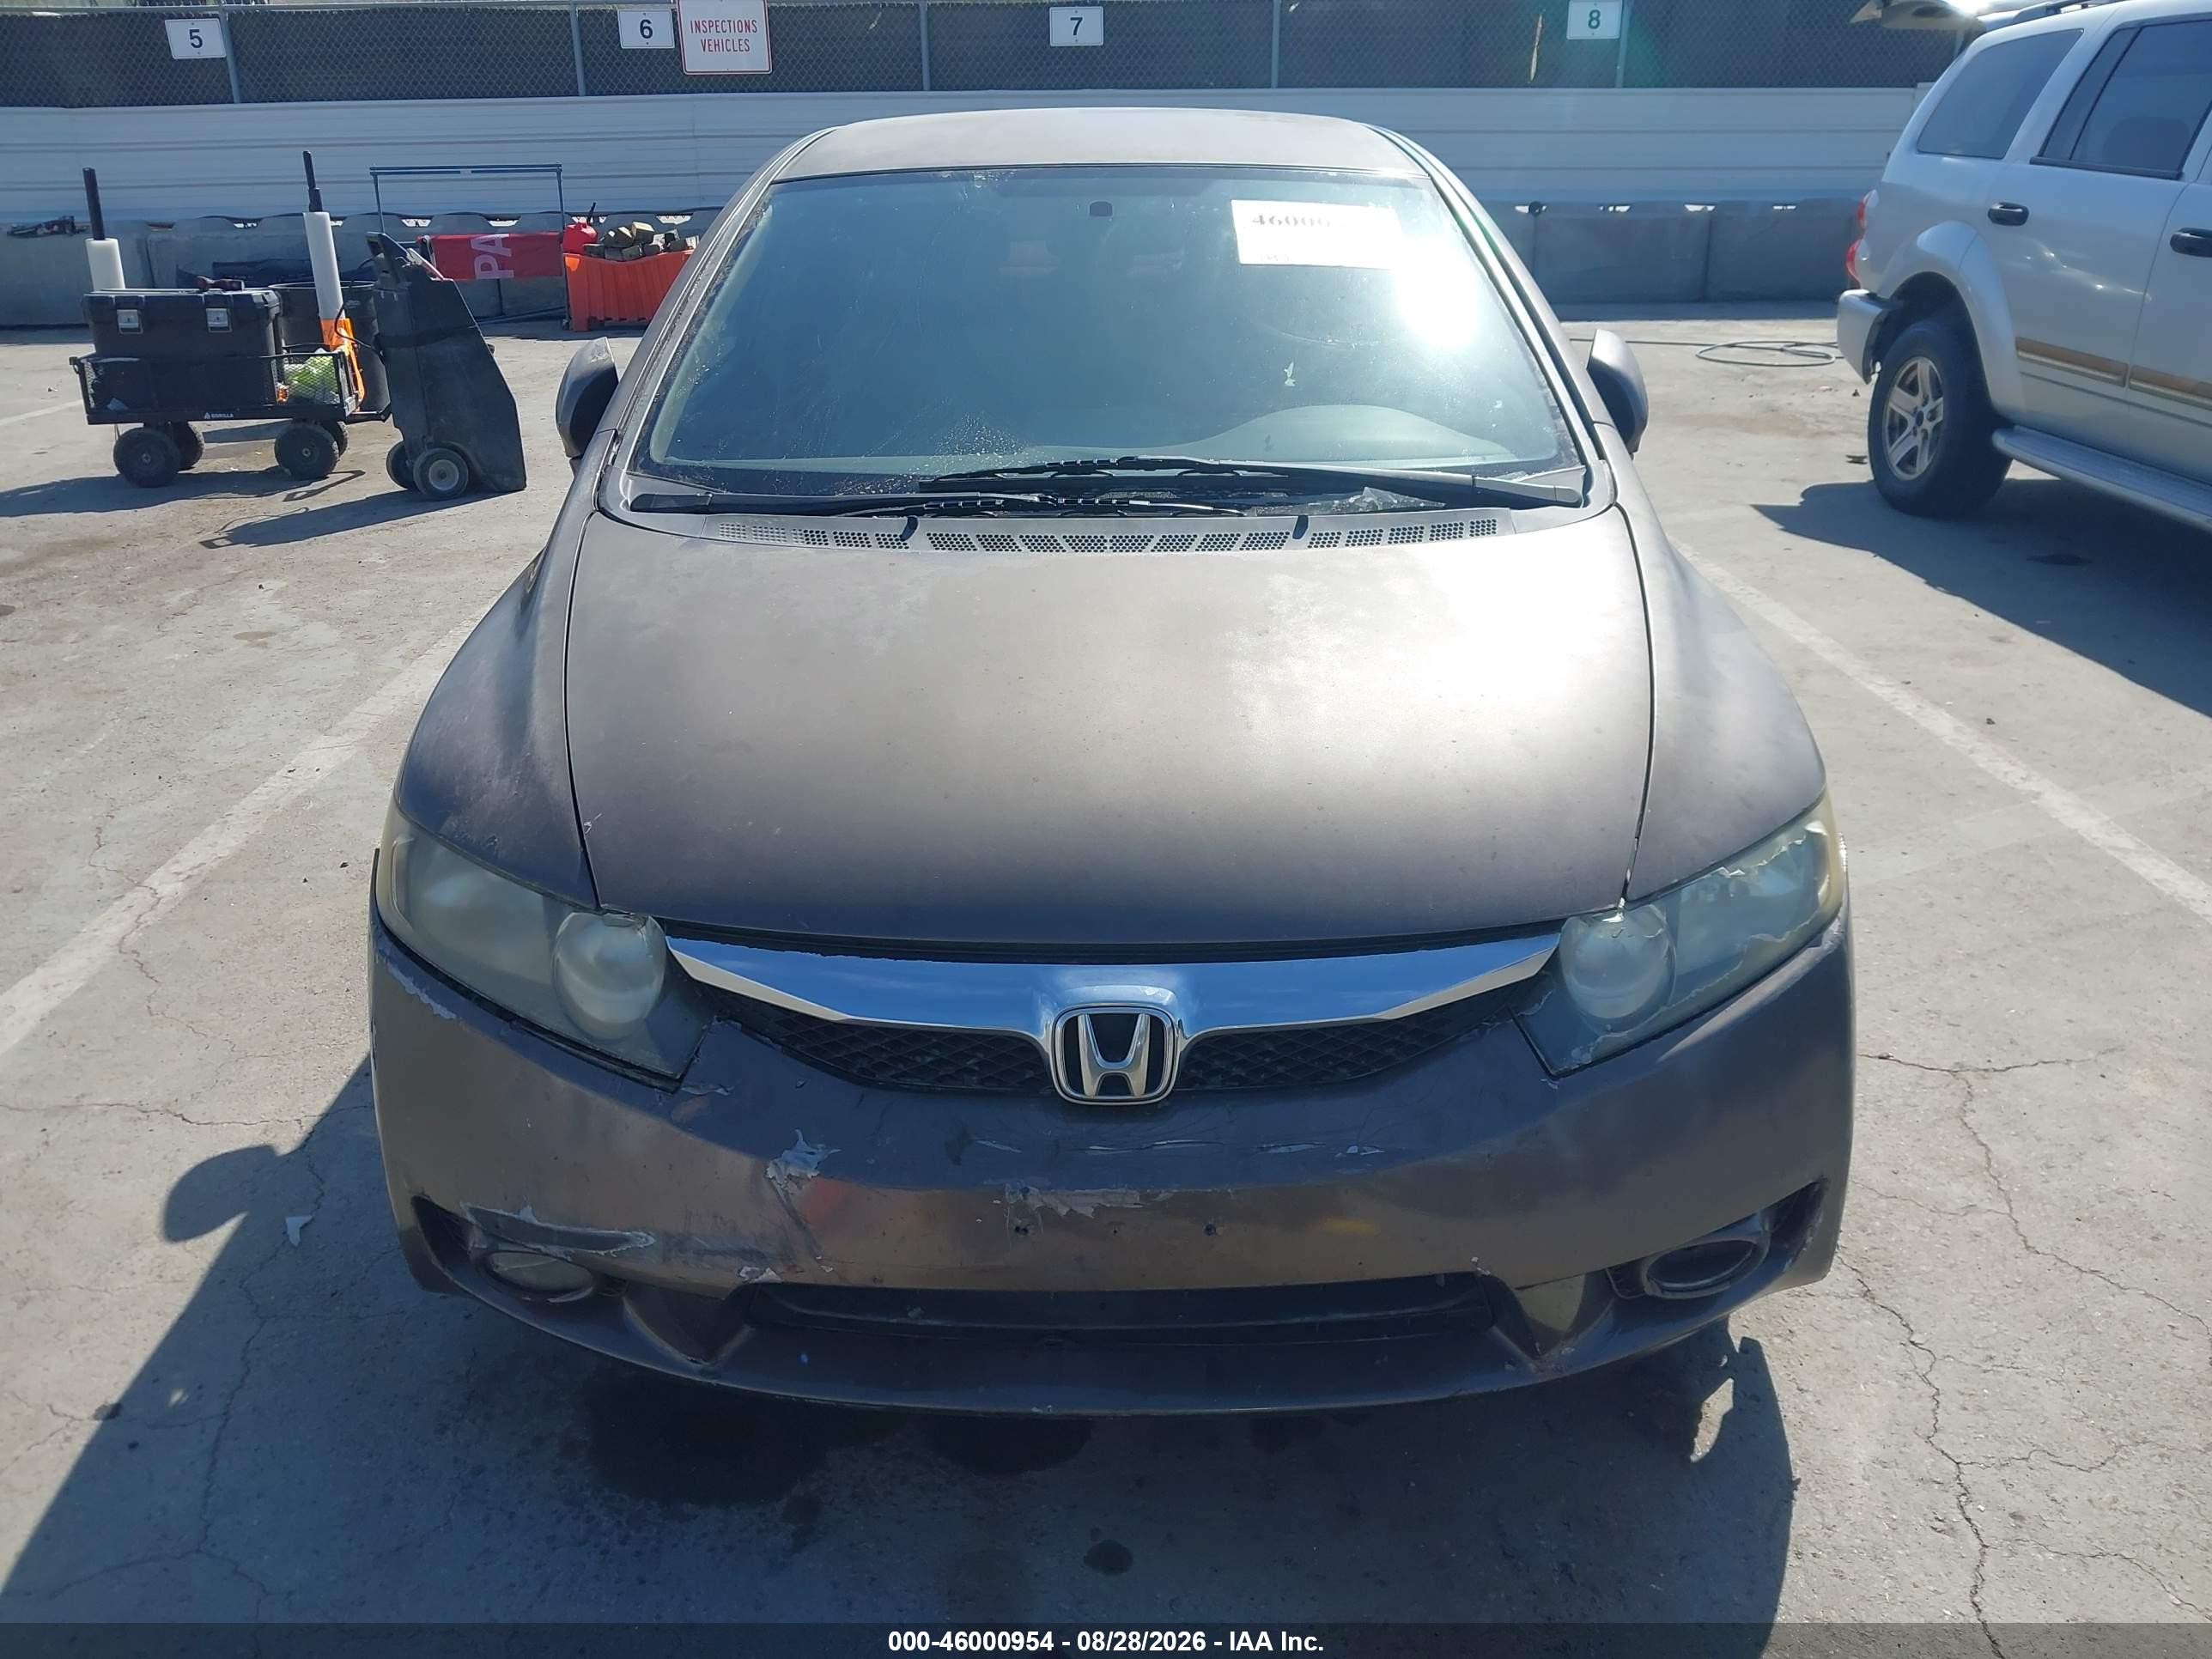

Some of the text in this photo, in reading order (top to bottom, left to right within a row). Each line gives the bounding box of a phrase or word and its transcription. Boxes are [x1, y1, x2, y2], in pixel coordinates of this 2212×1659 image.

[690, 19, 758, 33] INSPECTIONS
[1070, 16, 1083, 36] 7
[1588, 9, 1601, 29] 8
[189, 28, 204, 49] 5
[639, 19, 653, 40] 6
[700, 38, 750, 52] VEHICLES
